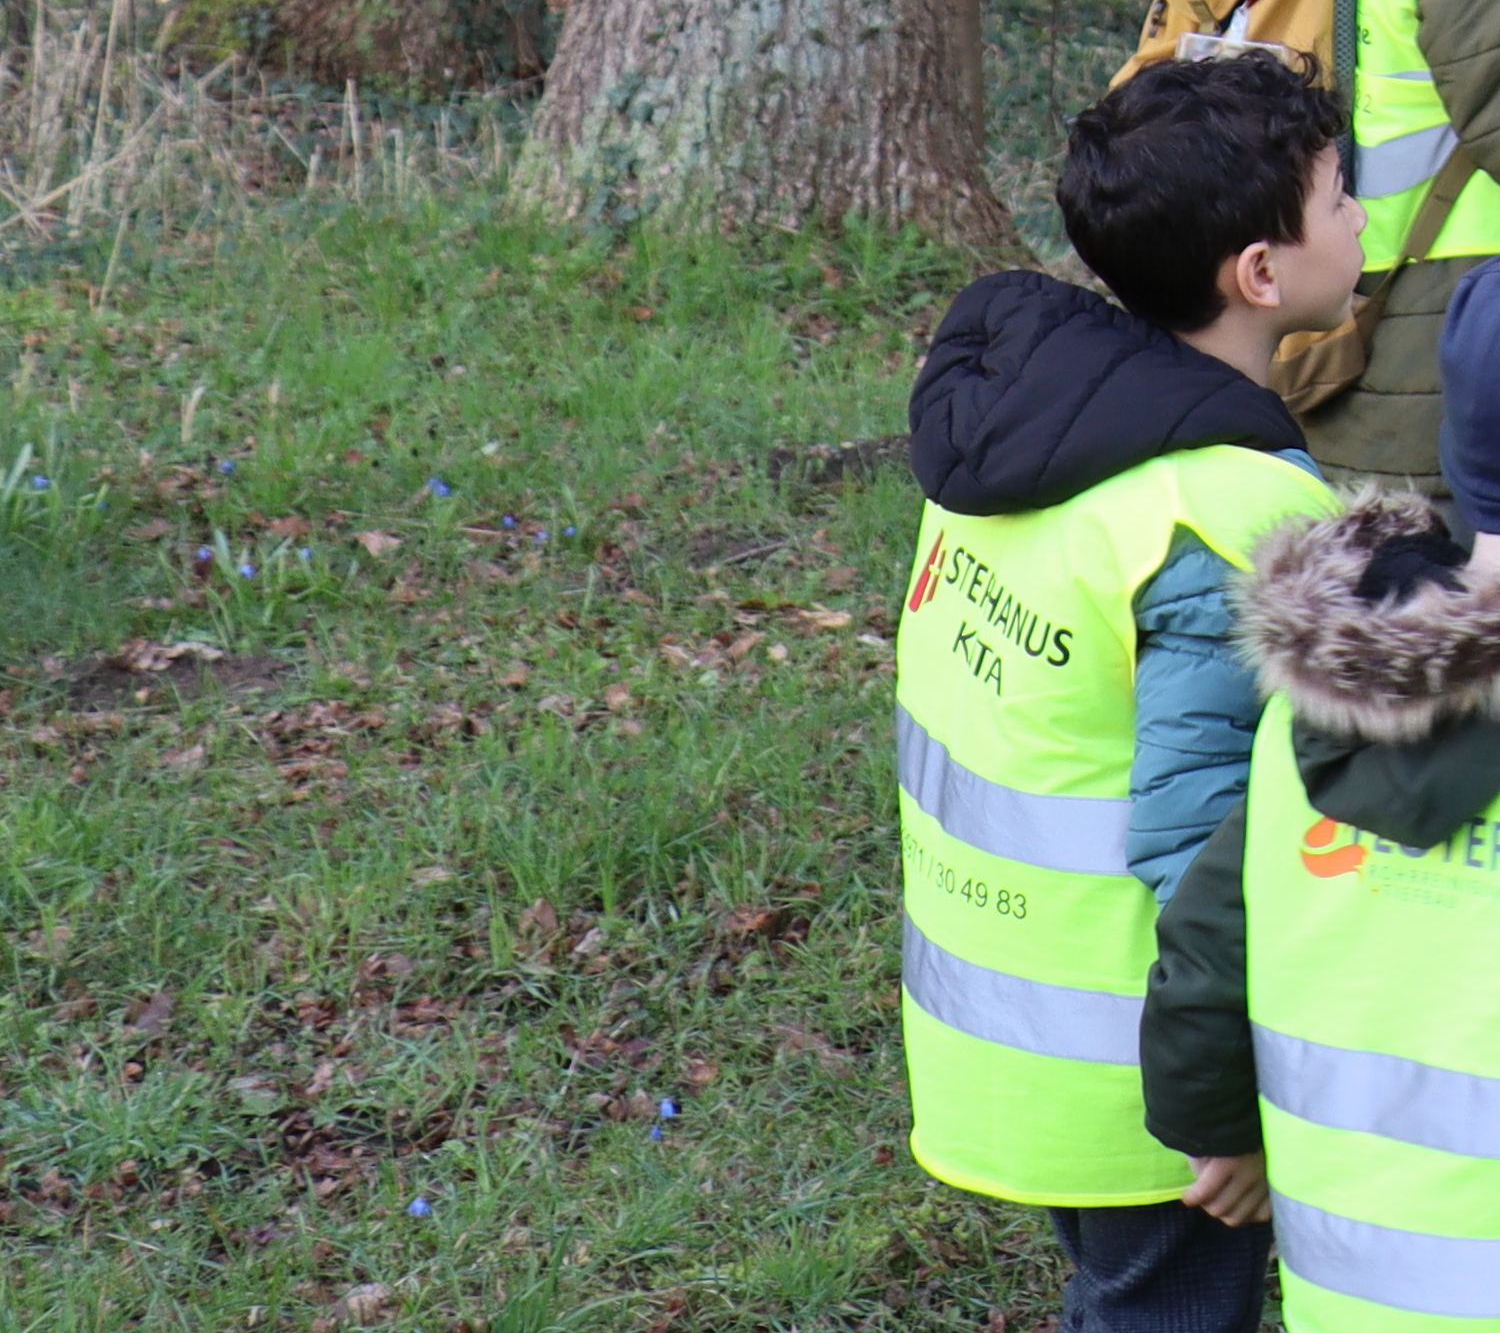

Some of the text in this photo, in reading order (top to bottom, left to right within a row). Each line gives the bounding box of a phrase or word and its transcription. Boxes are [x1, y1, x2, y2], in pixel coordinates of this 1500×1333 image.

[945, 545, 1074, 668] STEHANUS
[935, 861, 955, 894] 30
[960, 877, 988, 908] 49
[996, 889, 1027, 920] 83
